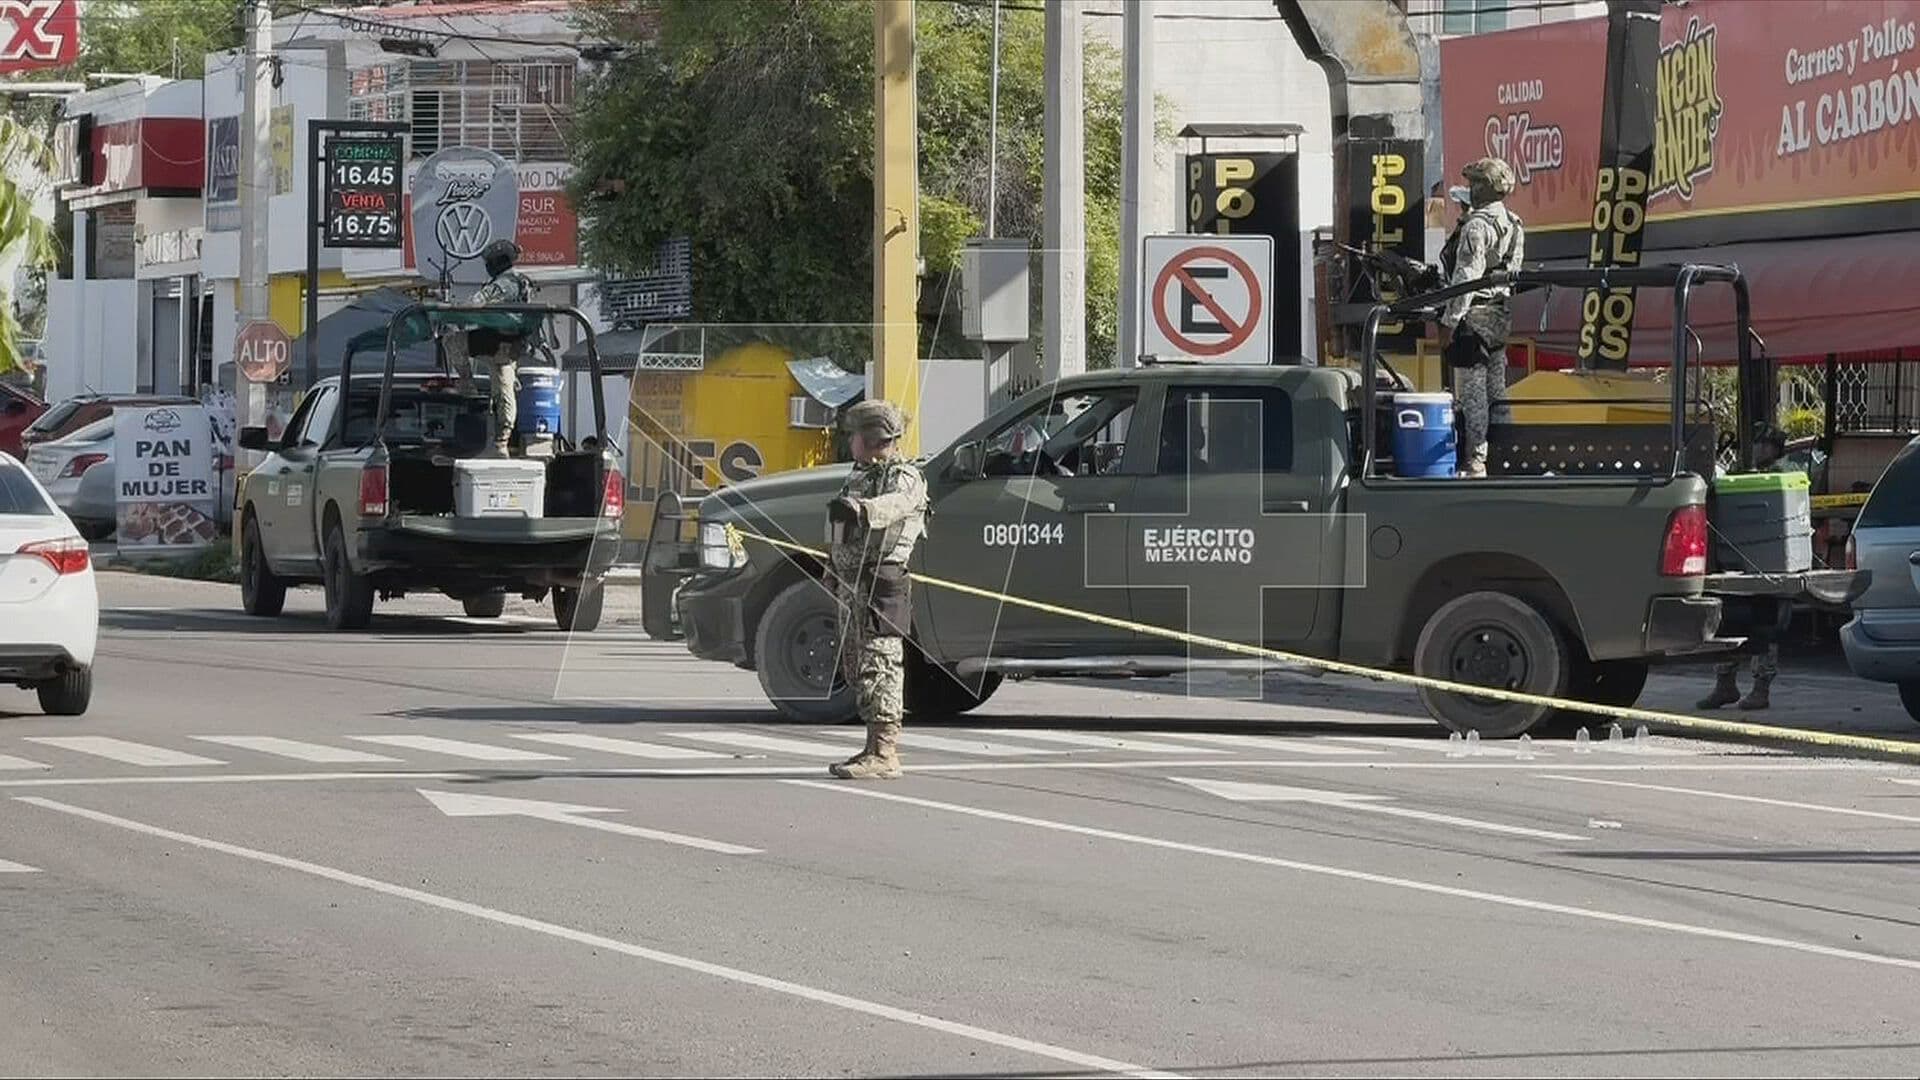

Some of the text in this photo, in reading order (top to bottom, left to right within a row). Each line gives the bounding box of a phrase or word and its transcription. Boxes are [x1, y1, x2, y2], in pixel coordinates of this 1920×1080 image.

[0, 0, 64, 60] X
[1786, 17, 1916, 85] Carnes y Pollos
[1497, 79, 1544, 105] CALIDAD
[1777, 58, 1920, 156] AL CARBÓN
[1650, 103, 1713, 194] ANDE
[337, 165, 394, 185] 16.45
[341, 193, 386, 209] VENTA
[521, 198, 556, 214] SUR
[334, 215, 391, 235] 16.75
[1578, 167, 1614, 359] POLOS
[1599, 168, 1648, 360] POLOS
[239, 339, 288, 363] ALTO
[135, 439, 191, 458] PAN
[148, 462, 181, 477] DE
[121, 480, 208, 496] MUJER
[983, 523, 1065, 546] 0801344
[1143, 525, 1256, 549] EJÉRCITO
[1145, 548, 1252, 564] MEXICANO
